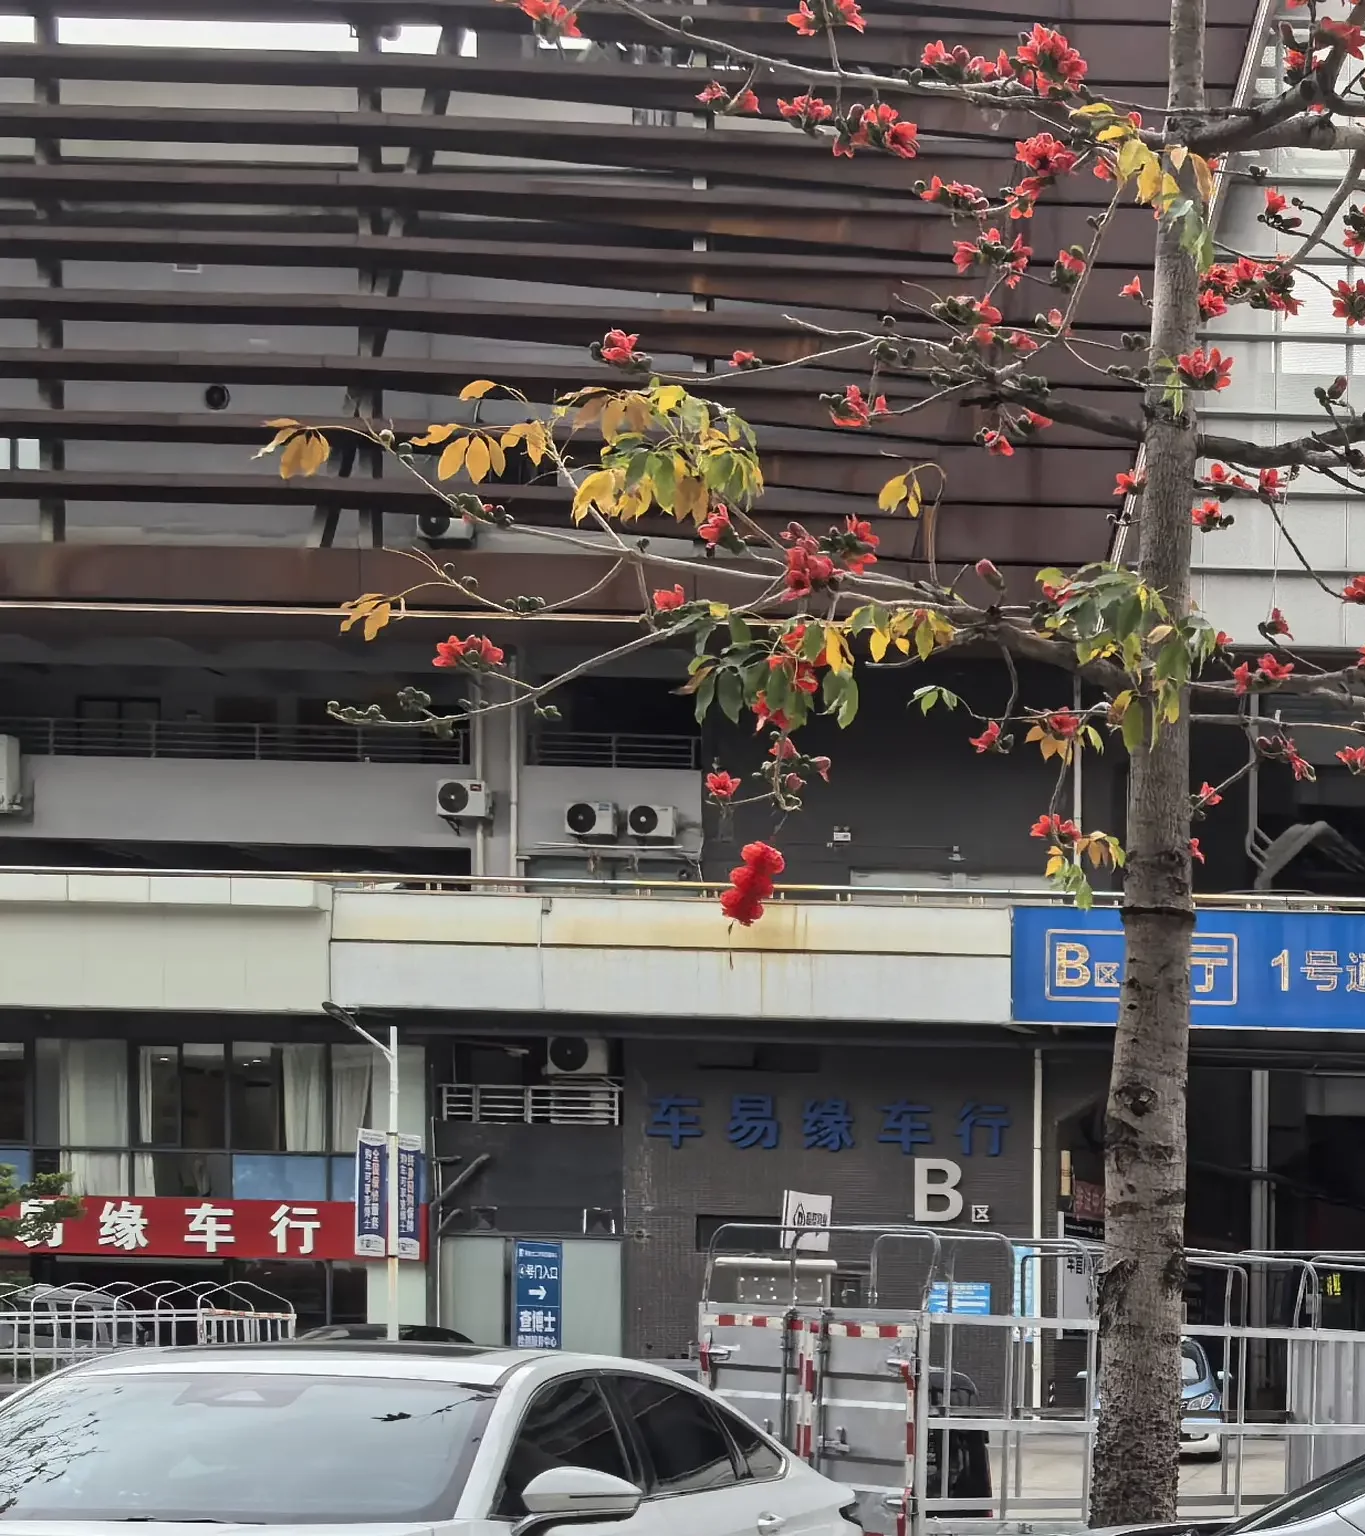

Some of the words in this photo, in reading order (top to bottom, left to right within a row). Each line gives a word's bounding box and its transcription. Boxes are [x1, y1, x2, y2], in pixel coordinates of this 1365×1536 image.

[1055, 942, 1229, 993] B区厅
[646, 1093, 1012, 1157] 车易缘车行
[519, 1310, 557, 1333] 查博士
